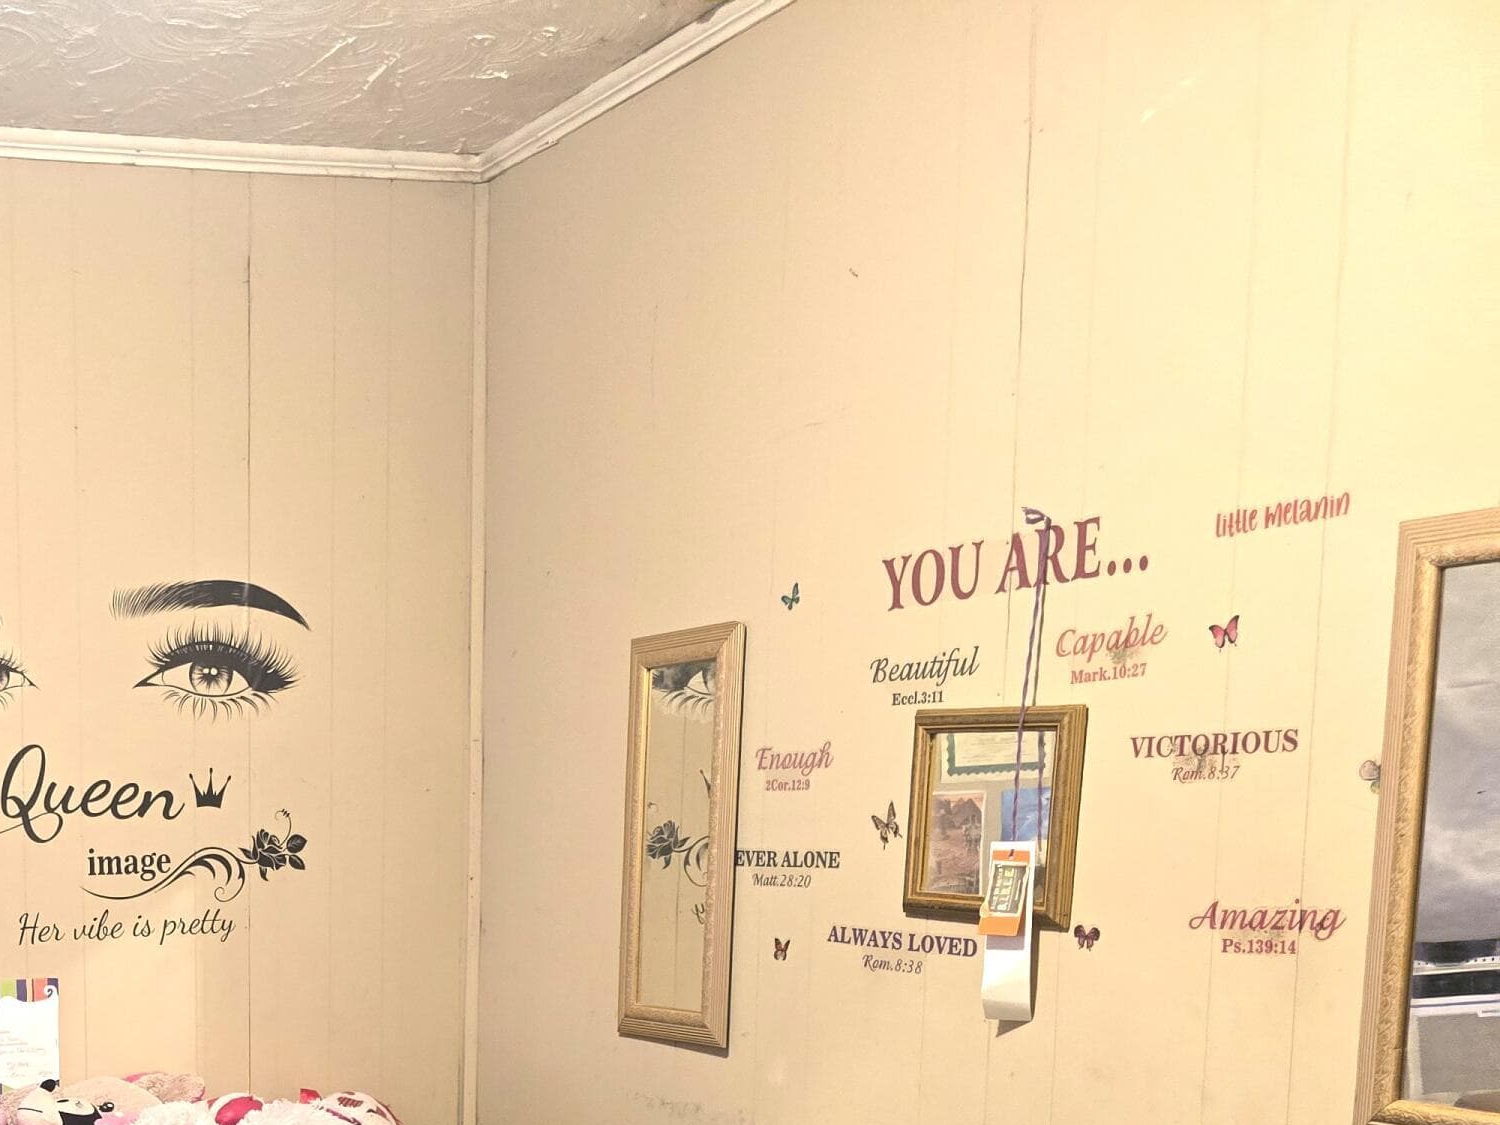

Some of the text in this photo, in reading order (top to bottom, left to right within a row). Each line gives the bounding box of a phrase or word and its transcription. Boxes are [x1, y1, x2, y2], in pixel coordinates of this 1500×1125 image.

[882, 517, 1149, 611] YOU ARE...
[1056, 612, 1168, 663] Capable
[869, 645, 980, 686] Beautiful
[1070, 663, 1148, 685] Mark.10:27
[892, 690, 944, 706] Eccl.3:11
[755, 741, 834, 776] Enough
[1130, 728, 1299, 758] VICTORIOUS
[87, 848, 173, 881] image
[734, 849, 840, 869] EVER ALONE
[752, 873, 812, 889] Matt.28:20
[19, 908, 236, 945] Her vibe is pretty
[1188, 898, 1347, 941] Amazing
[827, 925, 978, 958] ALWAYS LOVED
[1221, 938, 1297, 955] Ps.139:14
